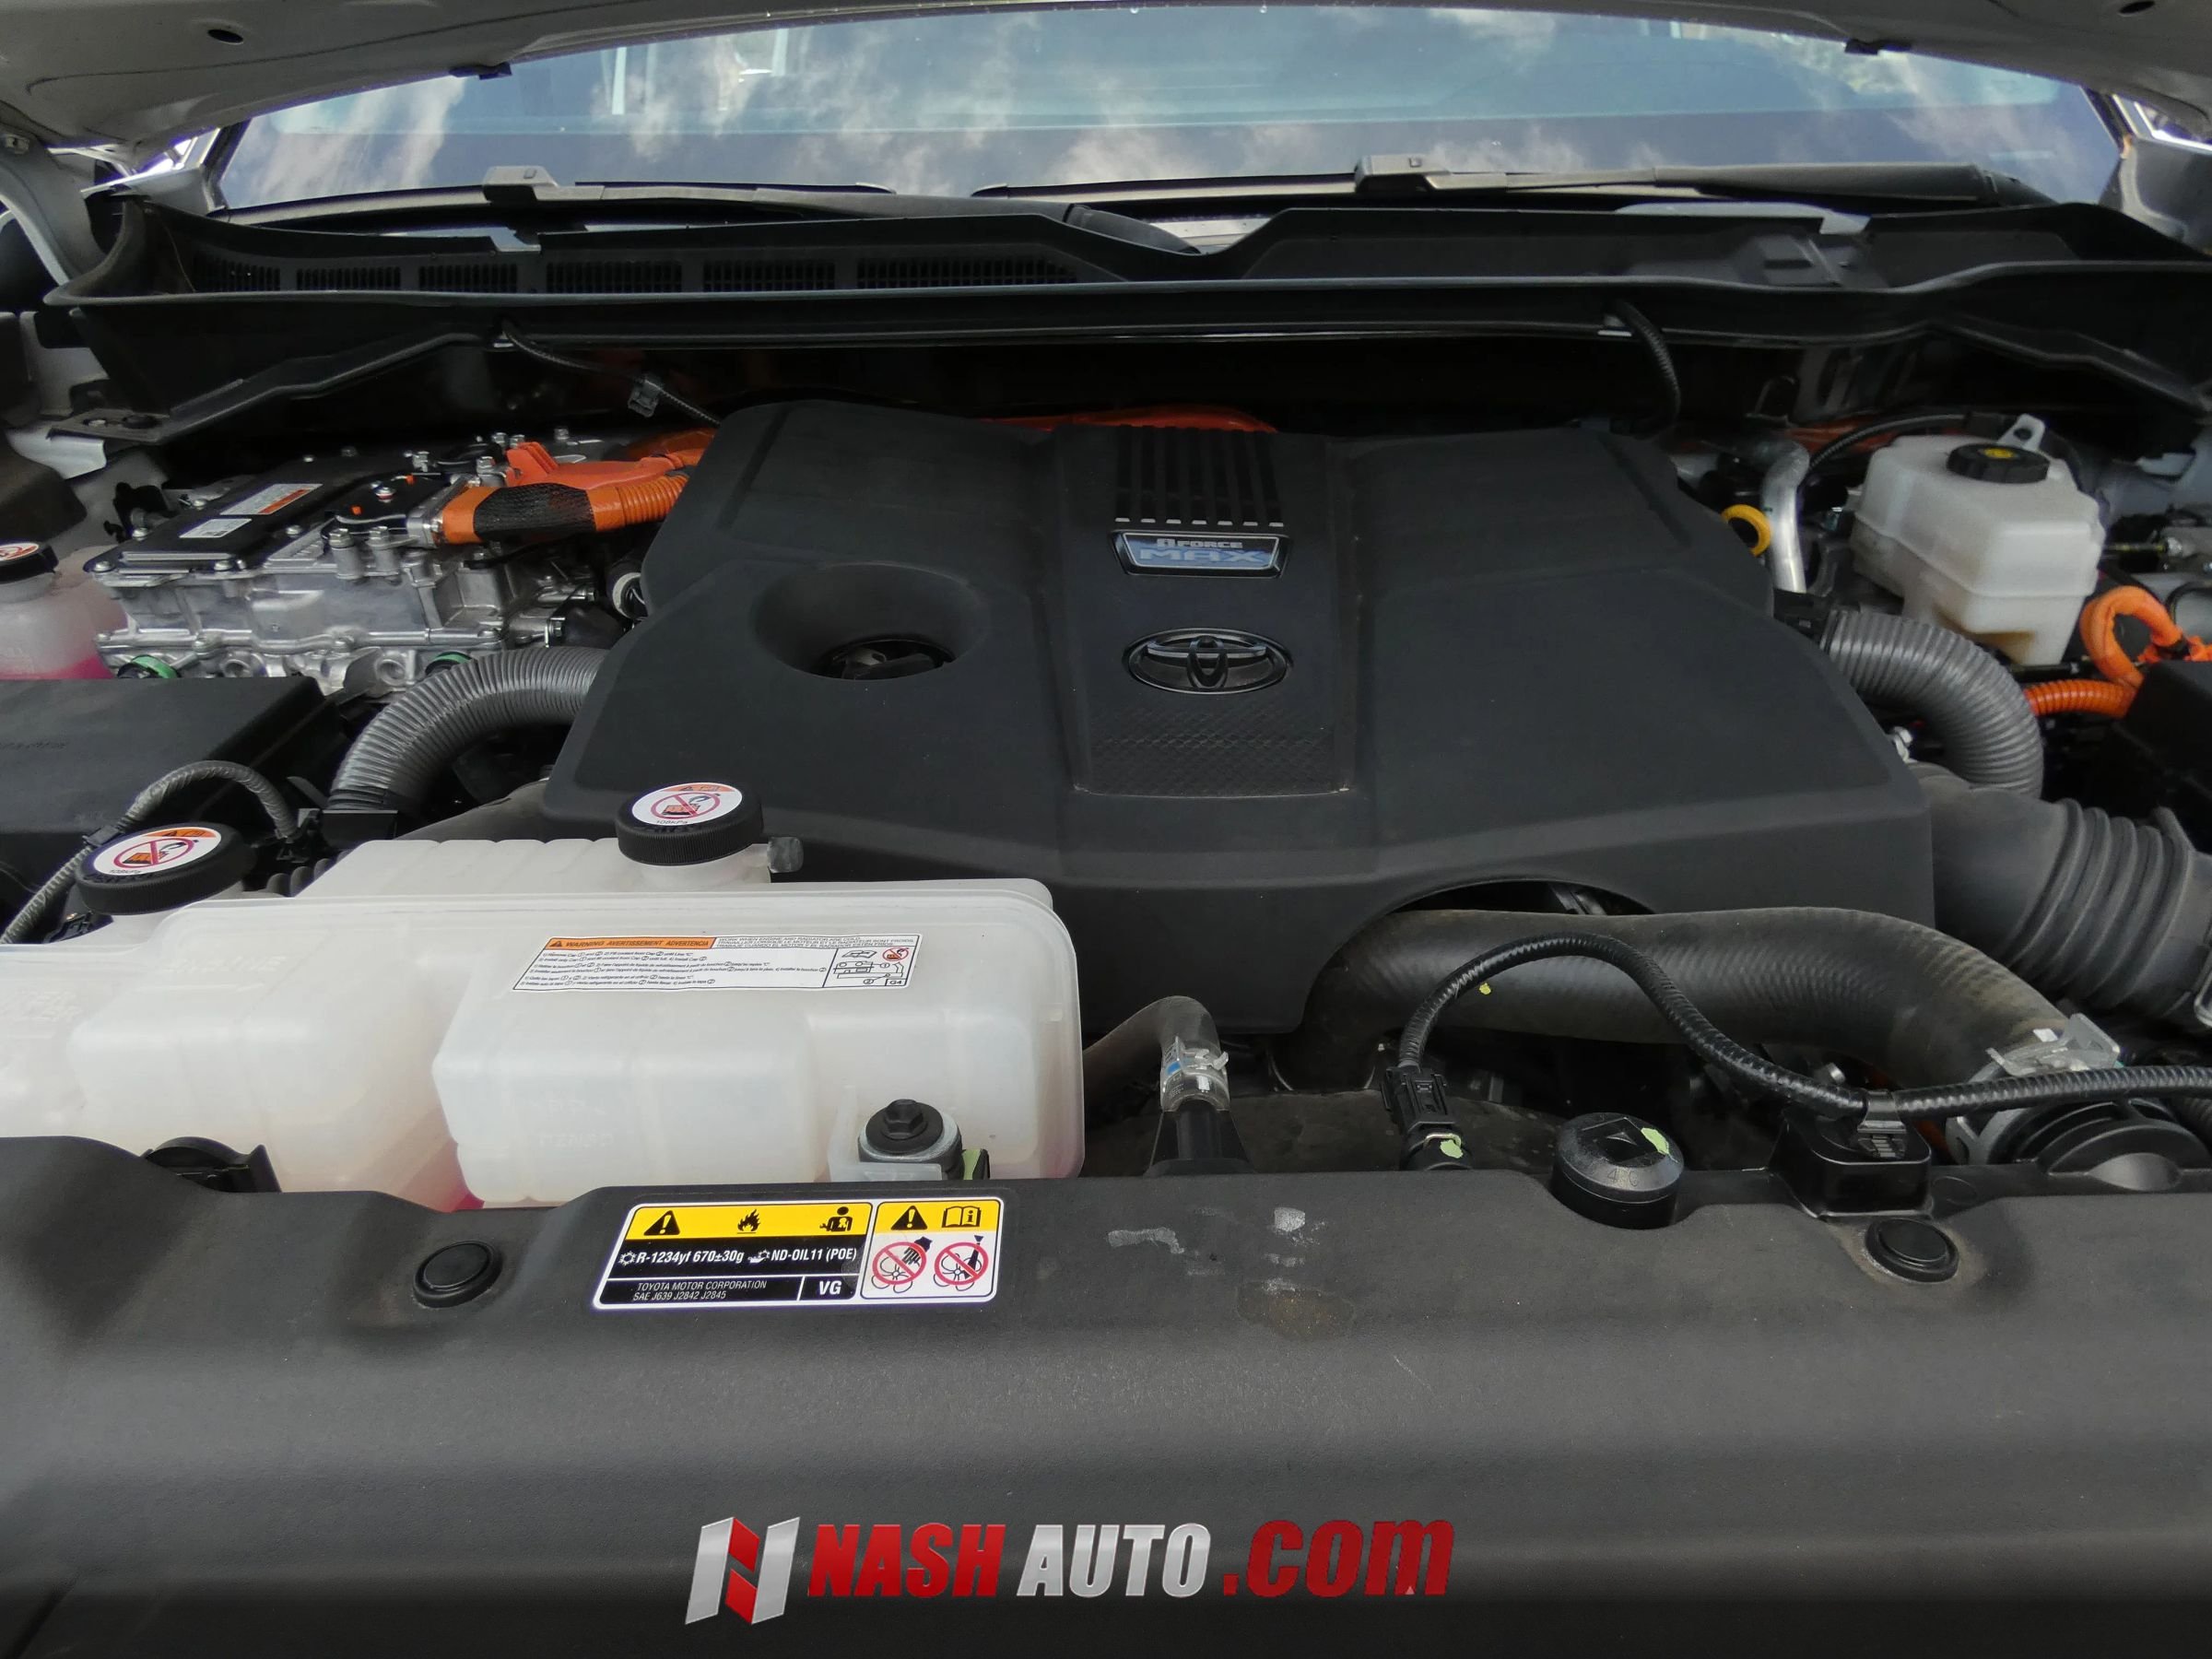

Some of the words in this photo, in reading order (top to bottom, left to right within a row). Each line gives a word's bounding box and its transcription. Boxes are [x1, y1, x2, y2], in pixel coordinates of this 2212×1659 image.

[1139, 547, 1265, 563] MAX
[636, 1250, 691, 1265] R-1234yf
[692, 1248, 745, 1264] 670±30g
[825, 1247, 857, 1262] (POE)
[636, 1282, 669, 1291] TOYOTA
[671, 1281, 704, 1290] MOTOR
[706, 1279, 767, 1289] CORPORATION
[818, 1281, 841, 1295] VG
[633, 1291, 651, 1300] SAE
[652, 1291, 672, 1300] J639
[674, 1291, 700, 1300] J2842
[701, 1290, 727, 1300] J2845
